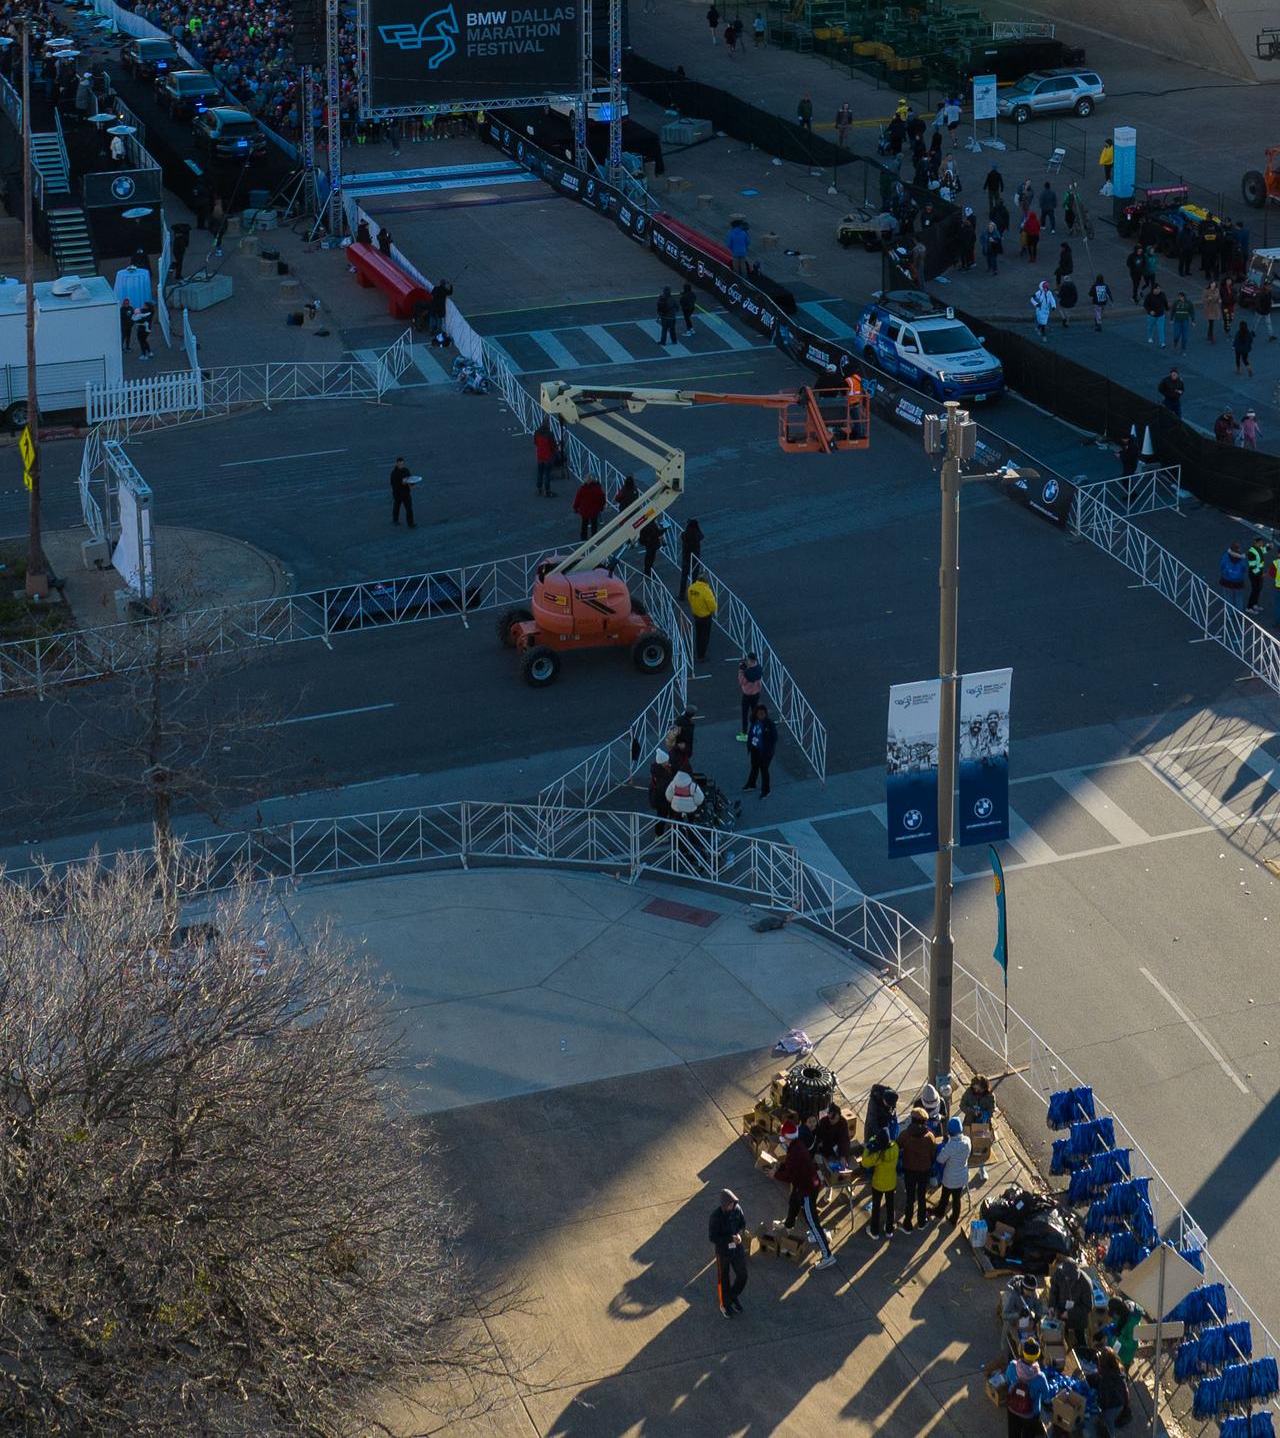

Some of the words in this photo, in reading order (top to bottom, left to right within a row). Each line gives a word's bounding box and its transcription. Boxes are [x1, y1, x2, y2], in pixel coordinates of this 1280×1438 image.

[466, 11, 507, 26] BMW
[511, 6, 576, 23] DALLAS
[466, 23, 561, 41] MARATHON
[466, 39, 545, 57] FESTIVAL
